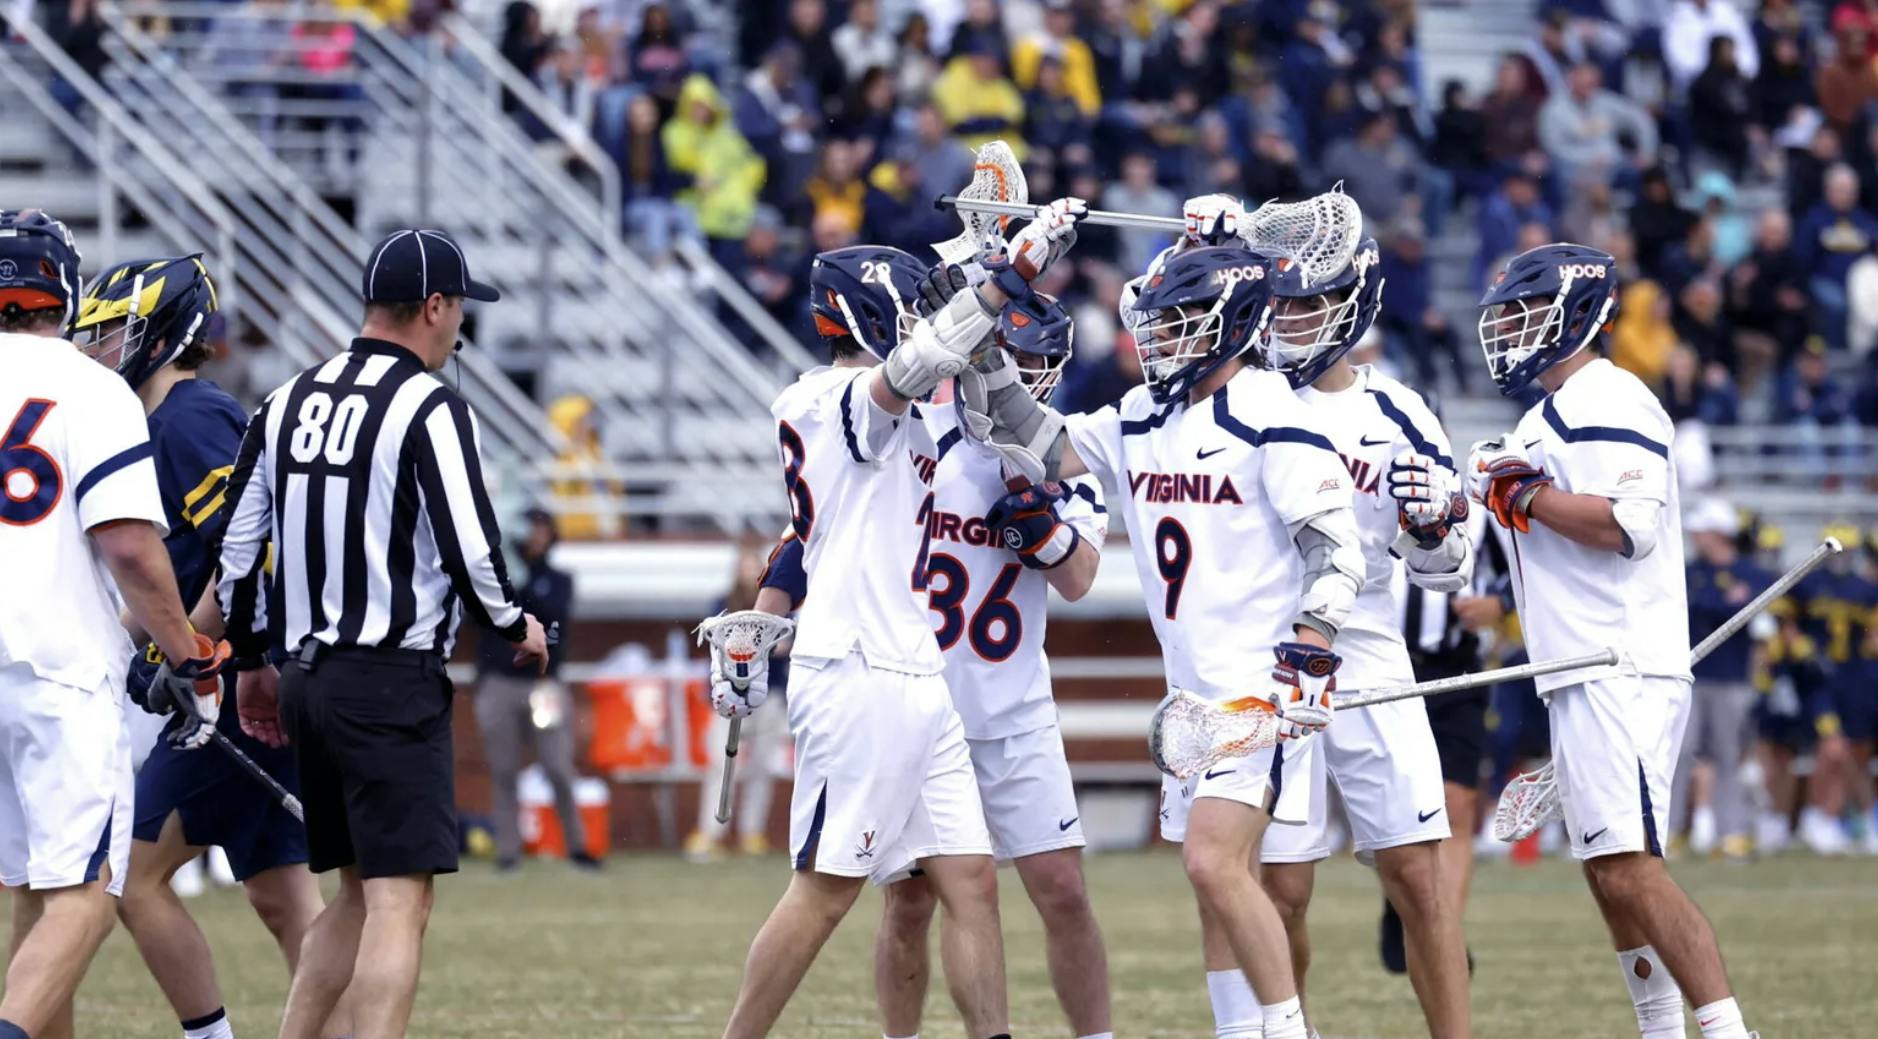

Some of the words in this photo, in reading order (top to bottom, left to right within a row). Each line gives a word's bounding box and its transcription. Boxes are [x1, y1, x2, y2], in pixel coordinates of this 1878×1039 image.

[1216, 265, 1265, 285] HOOS
[1559, 264, 1606, 280] HOOS
[0, 397, 63, 526] 6
[289, 391, 370, 466] 80
[928, 552, 1023, 663] 36
[1155, 515, 1193, 621] 9
